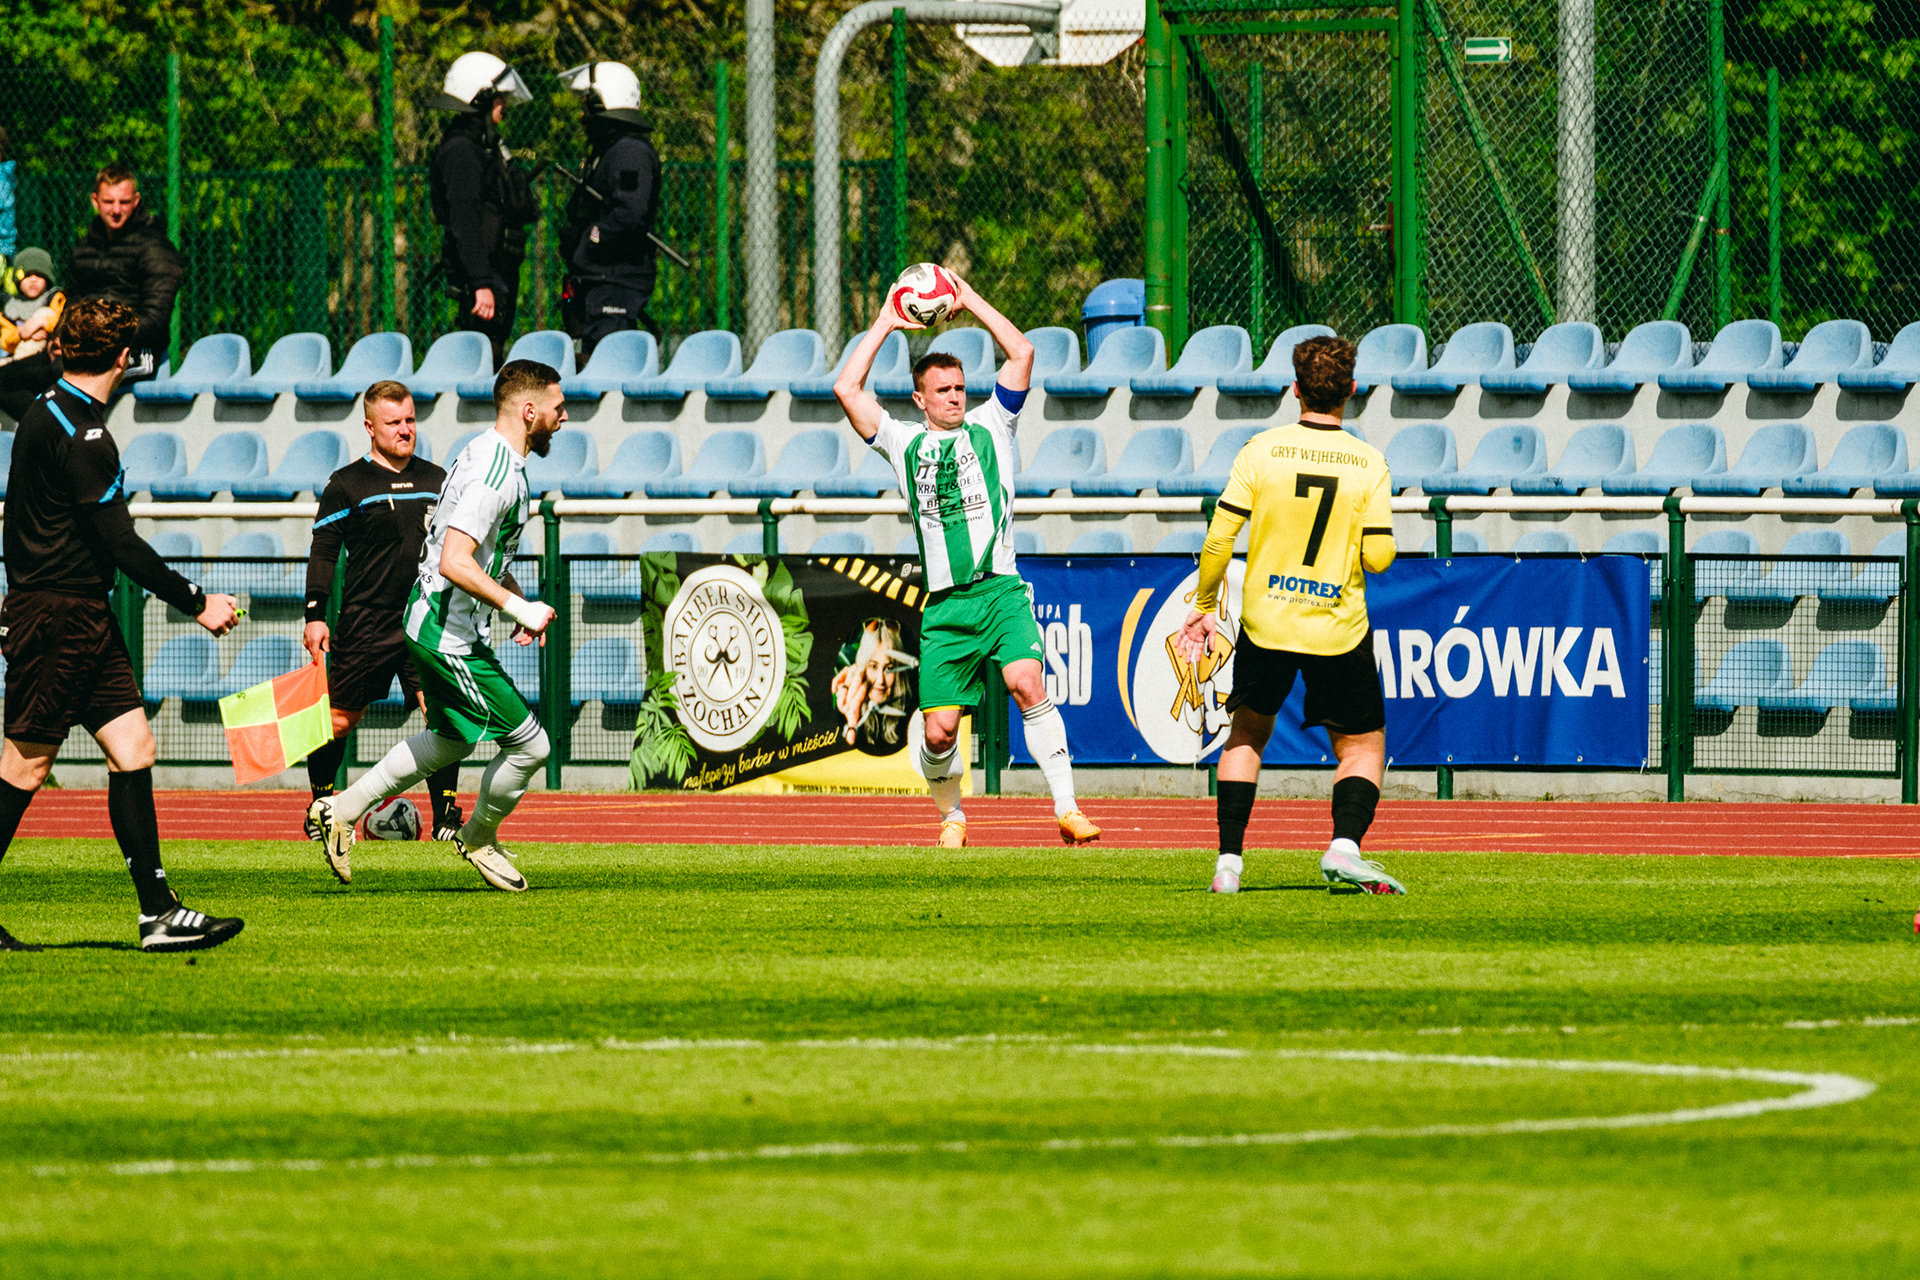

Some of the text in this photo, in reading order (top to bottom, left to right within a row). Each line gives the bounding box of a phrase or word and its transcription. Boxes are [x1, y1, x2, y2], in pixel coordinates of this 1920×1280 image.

[1271, 446, 1368, 469] GRYF WEJHEROWO
[1295, 473, 1339, 567] 7
[1268, 574, 1343, 599] PIOTREX
[674, 585, 772, 667] BARBER SHOP
[1031, 604, 1061, 619] UPA
[682, 686, 762, 731] ZOCHAN
[683, 726, 840, 791] najlepszy barber w mieście!
